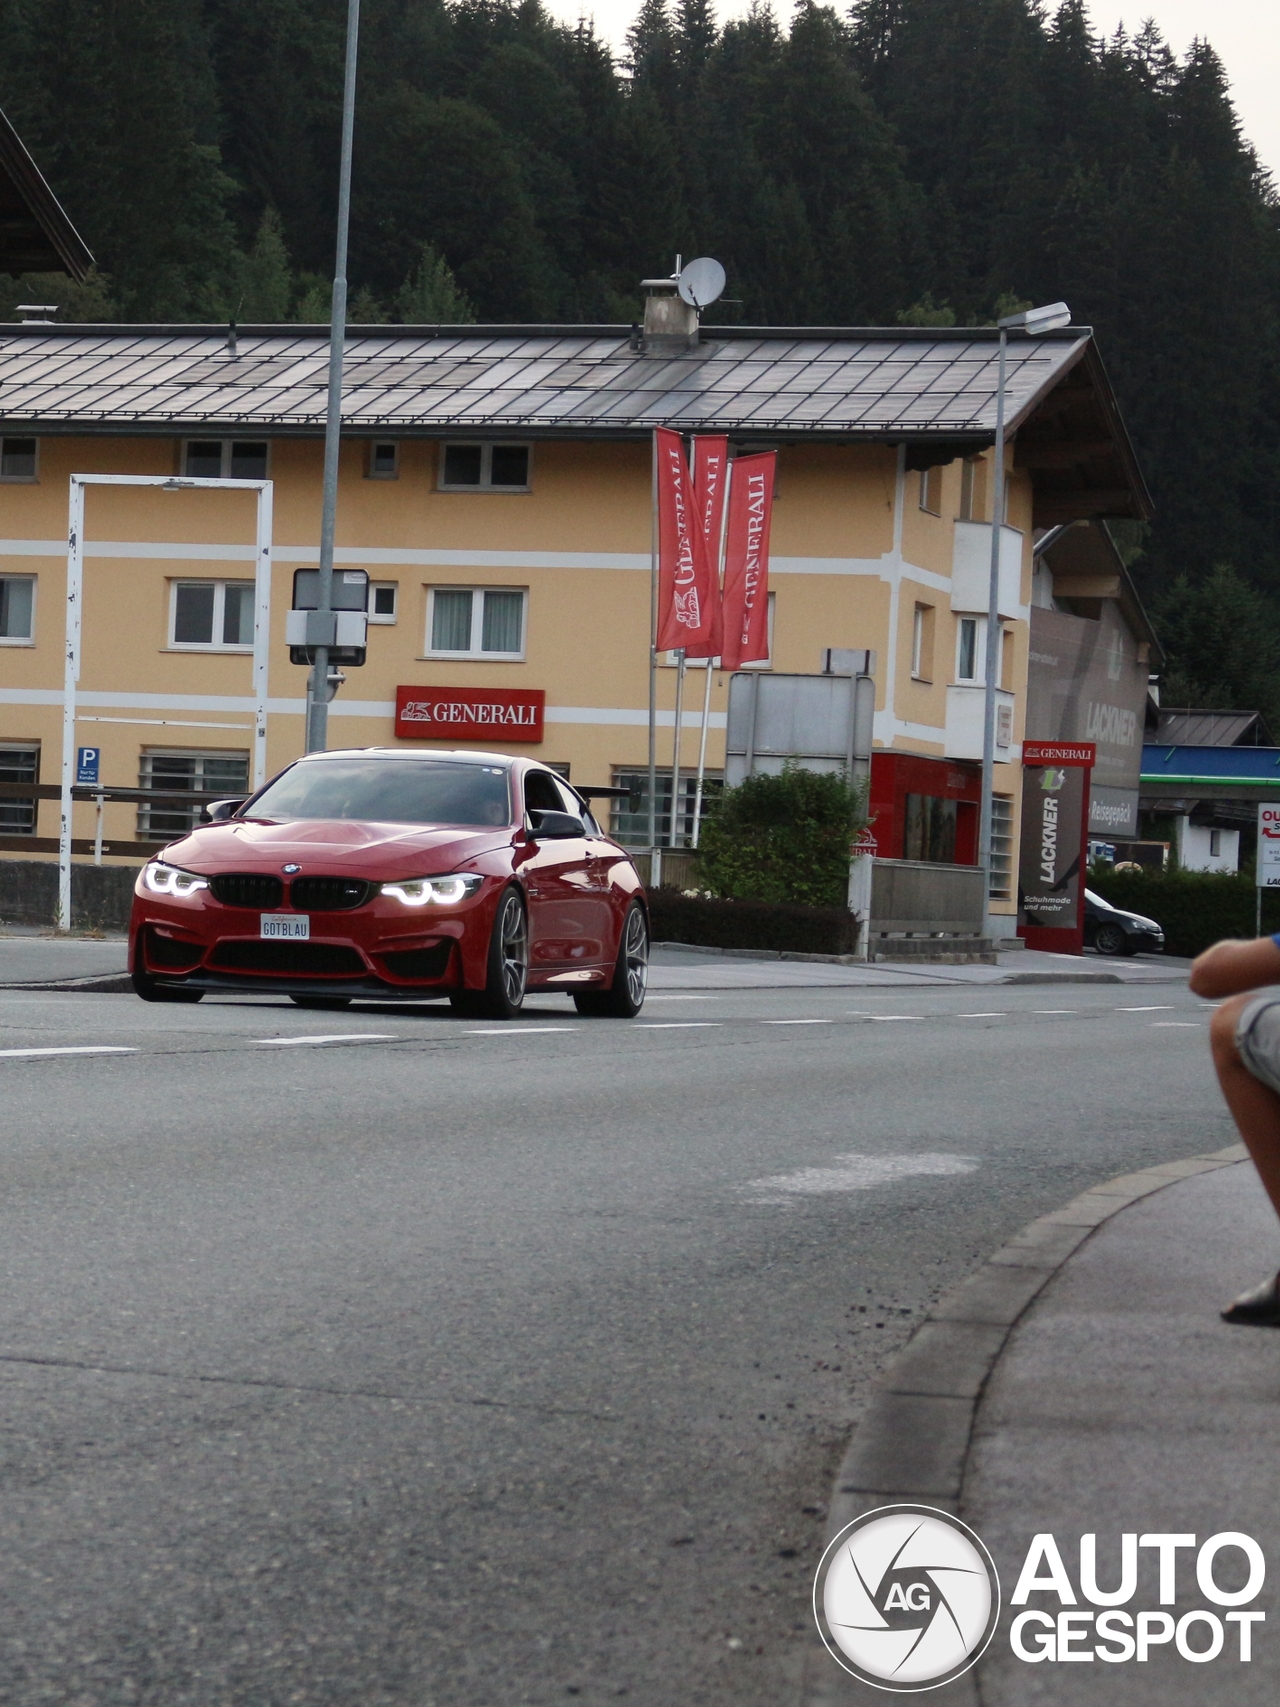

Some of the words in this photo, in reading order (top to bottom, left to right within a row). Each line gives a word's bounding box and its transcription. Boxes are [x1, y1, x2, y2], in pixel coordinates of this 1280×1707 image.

[433, 703, 537, 725] GENERALI
[1086, 702, 1137, 747] LACKNER
[83, 749, 96, 767] P
[1041, 748, 1092, 760] GENERALI
[1091, 800, 1131, 826] Reisegepäck
[1040, 797, 1059, 884] LACKNER
[1024, 896, 1071, 905] Schuhmode
[263, 922, 307, 937] GOTBLAU
